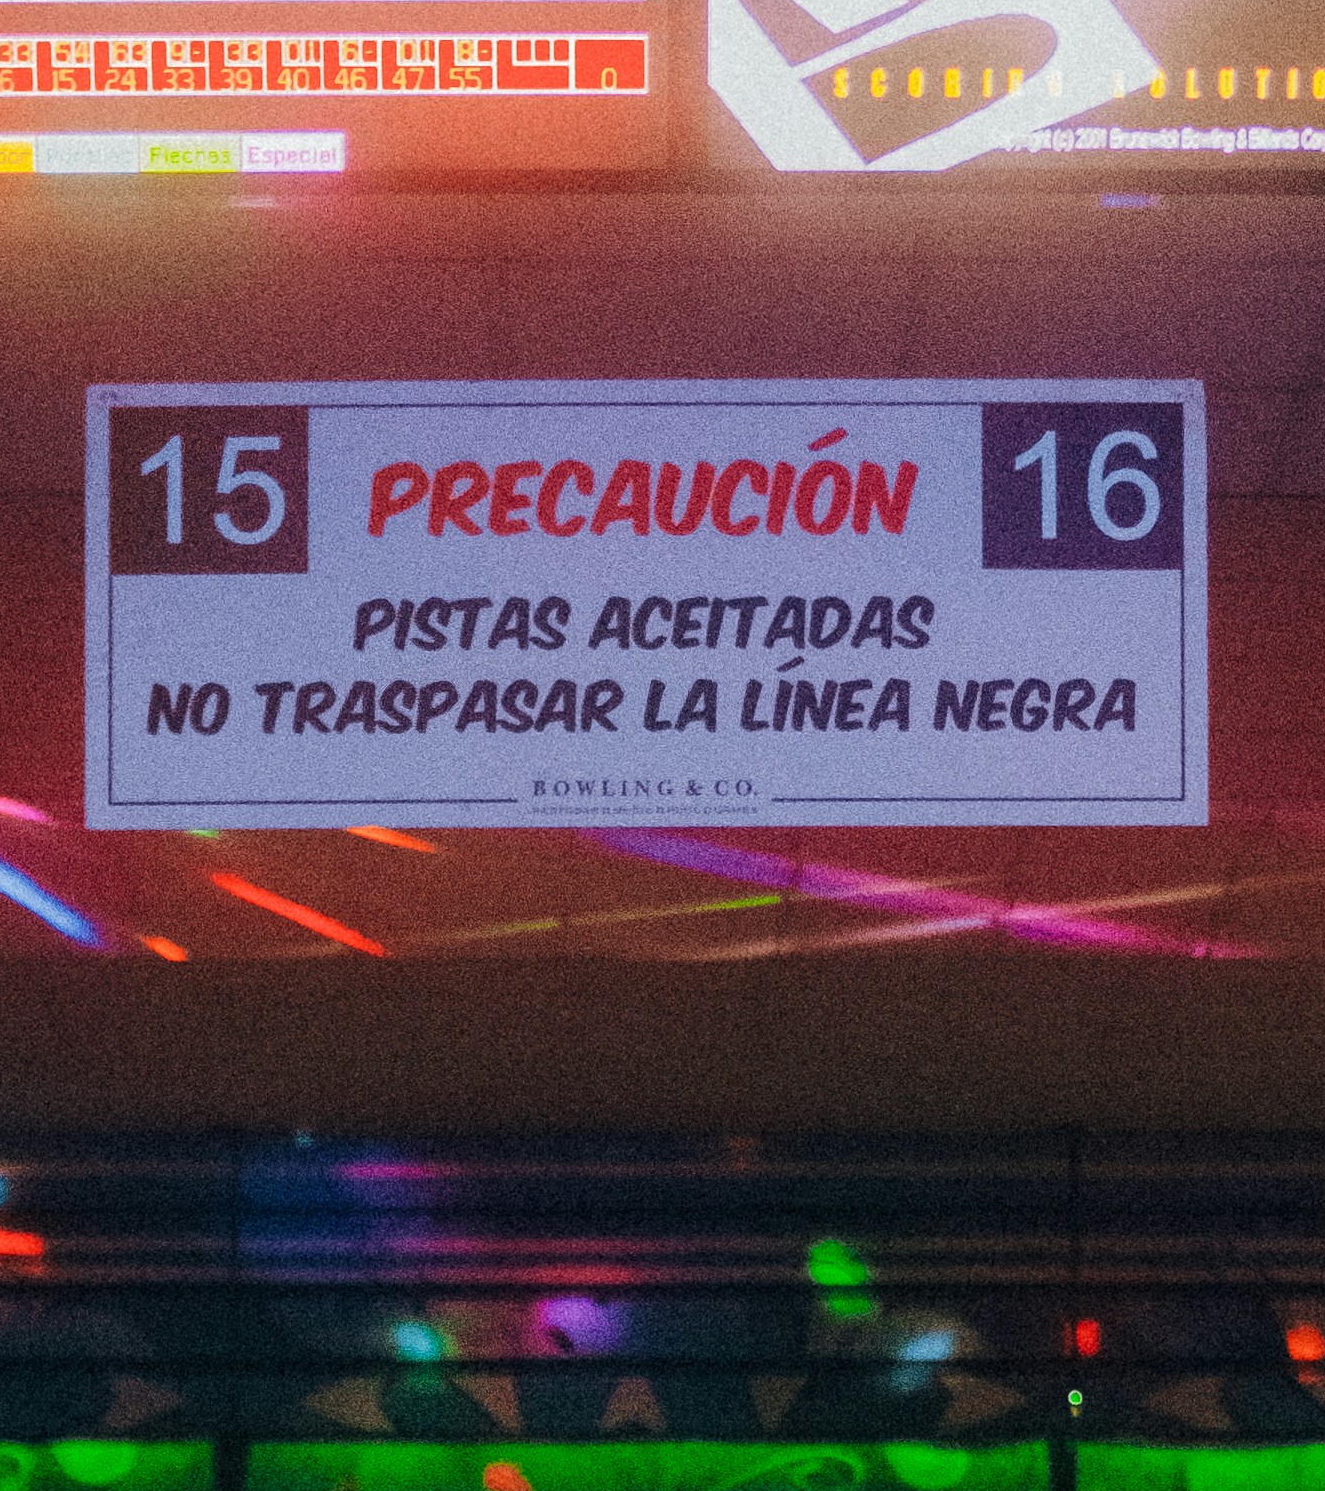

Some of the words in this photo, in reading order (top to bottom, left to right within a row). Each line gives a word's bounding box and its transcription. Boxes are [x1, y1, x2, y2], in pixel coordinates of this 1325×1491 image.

[52, 69, 77, 91] 15
[105, 68, 137, 91] 24
[163, 68, 195, 91] 33
[220, 68, 253, 90] 39
[277, 68, 310, 90] 40
[335, 68, 367, 90] 46
[392, 68, 425, 90] 47
[448, 67, 482, 90] 55
[601, 67, 618, 90] 0
[139, 434, 287, 545] 15
[366, 428, 919, 538] PRECAUCIÓN
[1013, 430, 1162, 542] 16
[352, 597, 569, 651] PISTAS
[587, 595, 935, 650] ACEITADAS
[146, 680, 231, 735] NO
[255, 678, 623, 734] TRASPASAR
[643, 678, 720, 732] LA
[741, 655, 910, 732] LÍNEA
[932, 678, 1138, 732] NEGRA
[532, 780, 673, 797] BOWLING
[684, 780, 702, 796] &
[713, 779, 758, 797] CO.
